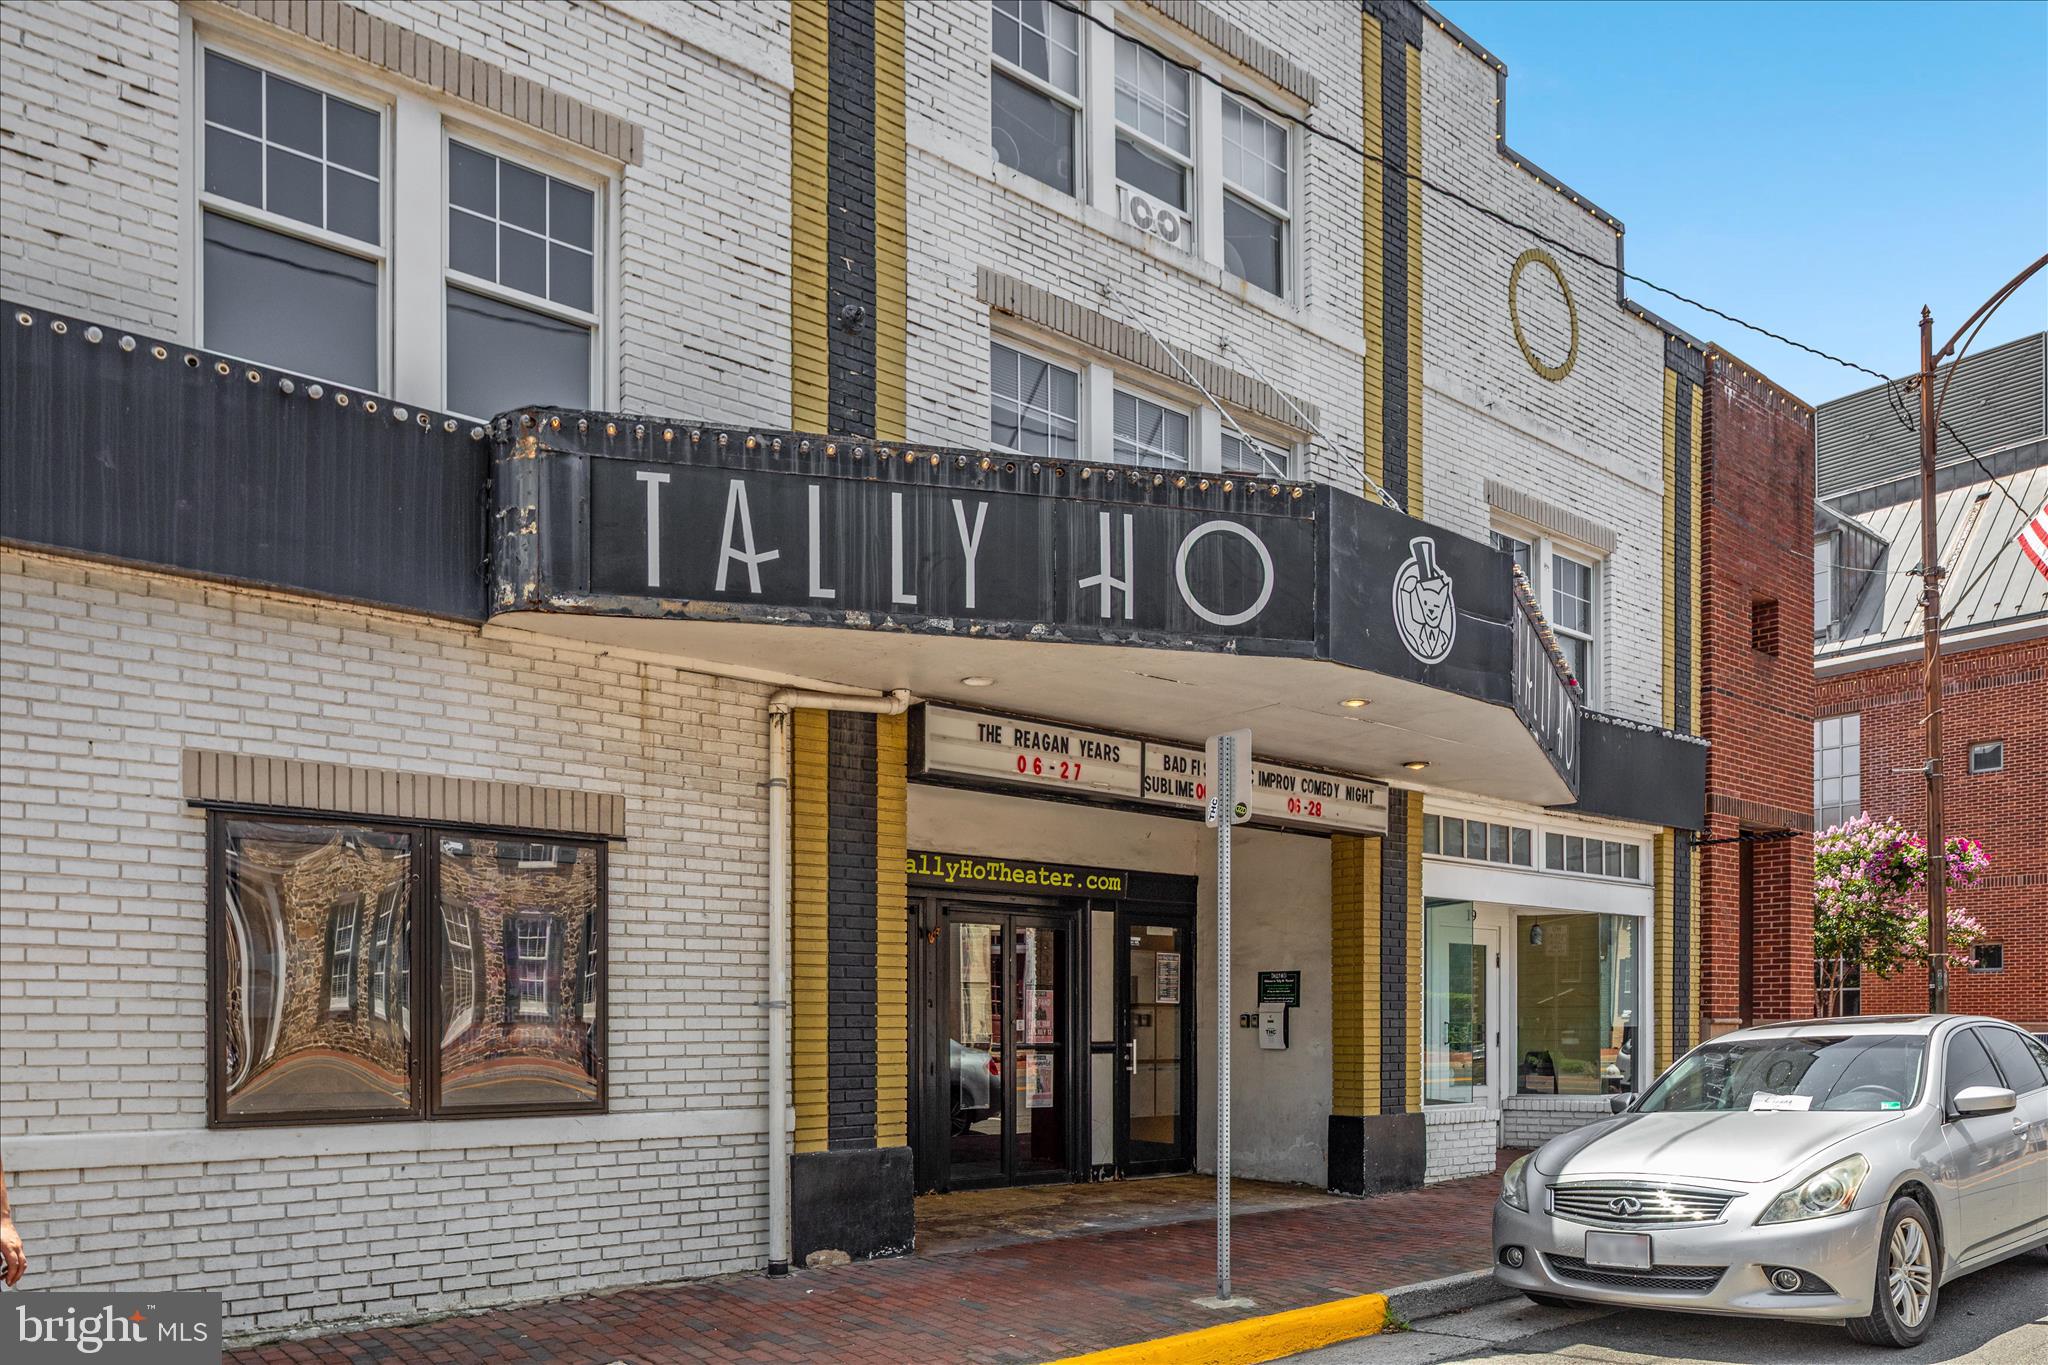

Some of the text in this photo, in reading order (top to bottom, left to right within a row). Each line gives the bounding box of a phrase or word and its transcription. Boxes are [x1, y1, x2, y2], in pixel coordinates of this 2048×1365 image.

[636, 471, 1275, 626] TALLY HO
[1517, 606, 1552, 740] TALLY
[978, 723, 1120, 763] THE REAGAN YEARS
[1017, 755, 1081, 780] 06-27
[1163, 754, 1187, 773] BAD
[1144, 775, 1206, 800] SUBLIME 0
[1258, 770, 1375, 805] IMPROV COMEDY NIGHT
[1208, 798, 1218, 820] THC
[1287, 797, 1322, 817] 06-28
